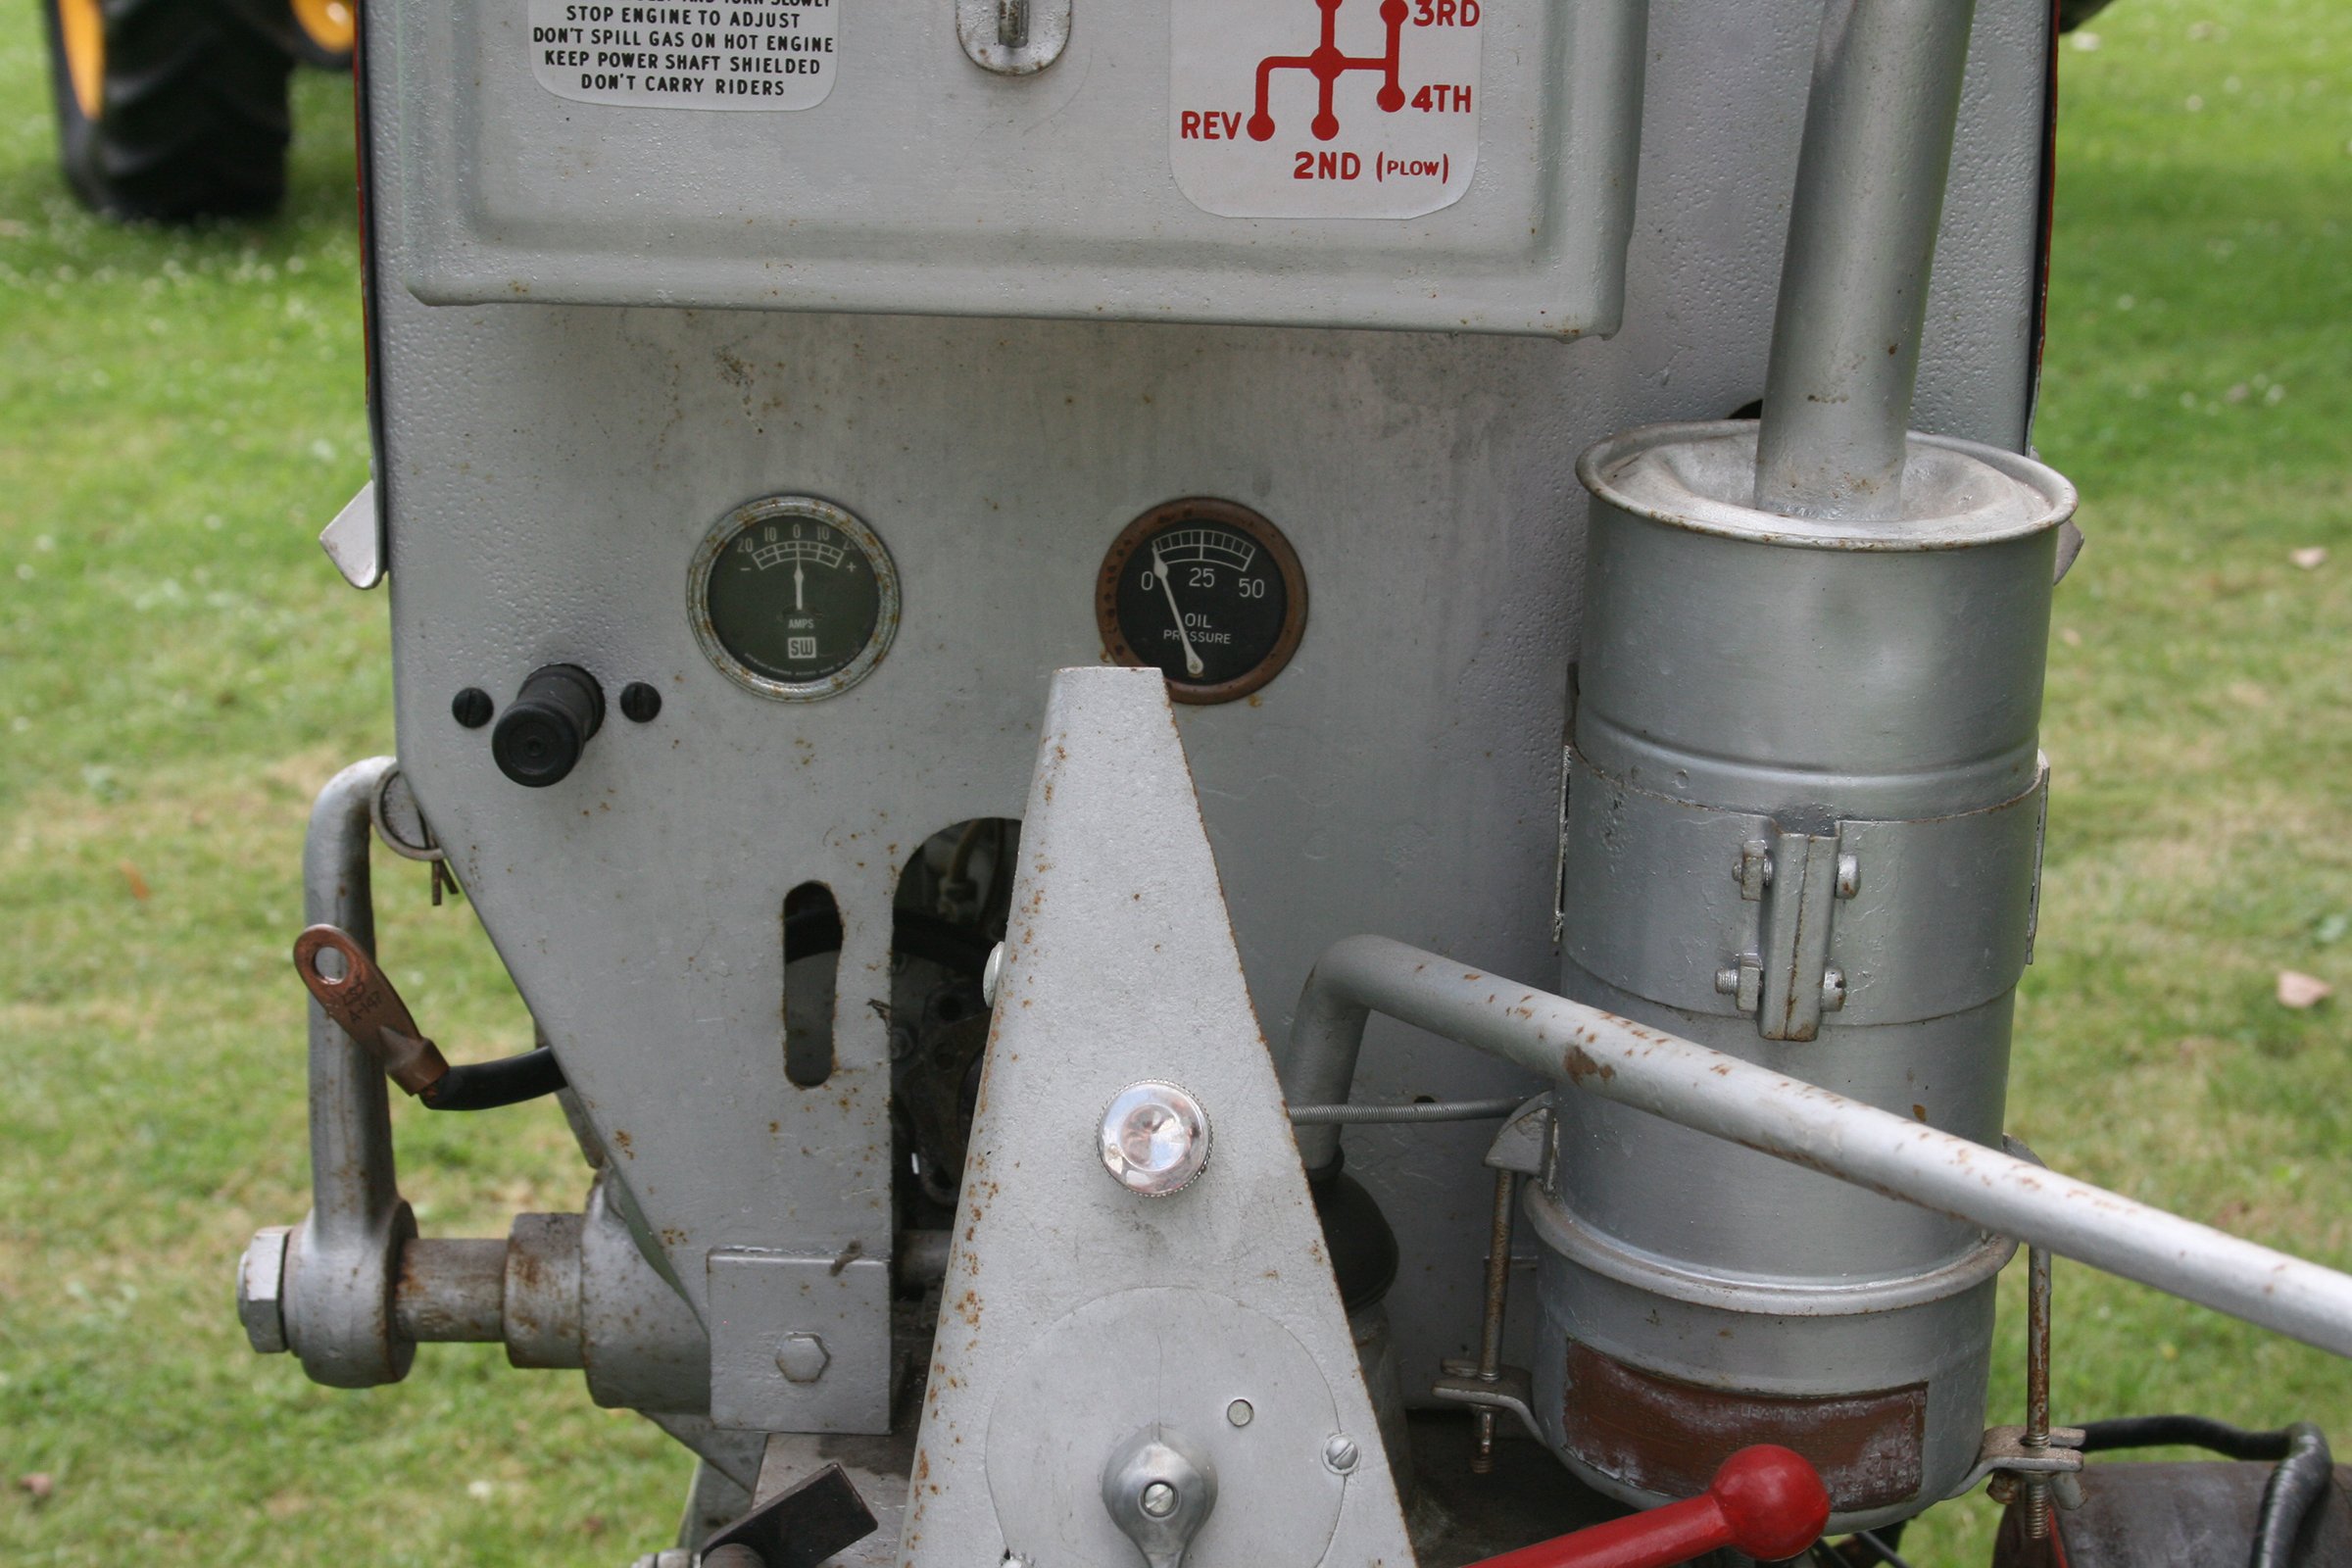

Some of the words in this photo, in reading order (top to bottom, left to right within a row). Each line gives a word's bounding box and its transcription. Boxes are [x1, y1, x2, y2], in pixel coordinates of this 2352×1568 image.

[566, 6, 613, 22] STOP
[622, 8, 691, 24] ENGINE
[698, 10, 720, 25] TO
[730, 12, 800, 27] ADJUST
[1413, 0, 1480, 26] 3RD
[534, 27, 583, 43] DON'T
[591, 29, 641, 45] SPILL
[650, 30, 684, 47] GAS
[692, 32, 714, 48] ON
[724, 34, 758, 49] HOT
[767, 35, 833, 52] ENGINE
[545, 50, 589, 66] KEEP
[598, 52, 658, 69] POWER
[665, 54, 720, 71] SHAFT
[730, 57, 819, 74] SHIELDED
[581, 74, 635, 90] DON'T
[646, 76, 704, 92] CARRY
[716, 78, 784, 95] RIDERS
[1411, 84, 1471, 113] 4TH
[1181, 110, 1242, 139] REV
[1294, 152, 1360, 180] 2ND
[1377, 153, 1448, 182] (PLOW)
[737, 538, 753, 553] 20
[764, 527, 777, 542] 10
[793, 524, 802, 538] 0
[817, 526, 829, 540] 10
[1141, 571, 1153, 590] 0
[1189, 567, 1214, 587] 25
[1239, 578, 1264, 598] 50
[788, 618, 814, 629] AMPS
[1185, 613, 1212, 628] OIL
[790, 640, 813, 657] SW
[1163, 629, 1231, 644] PRSSURE
